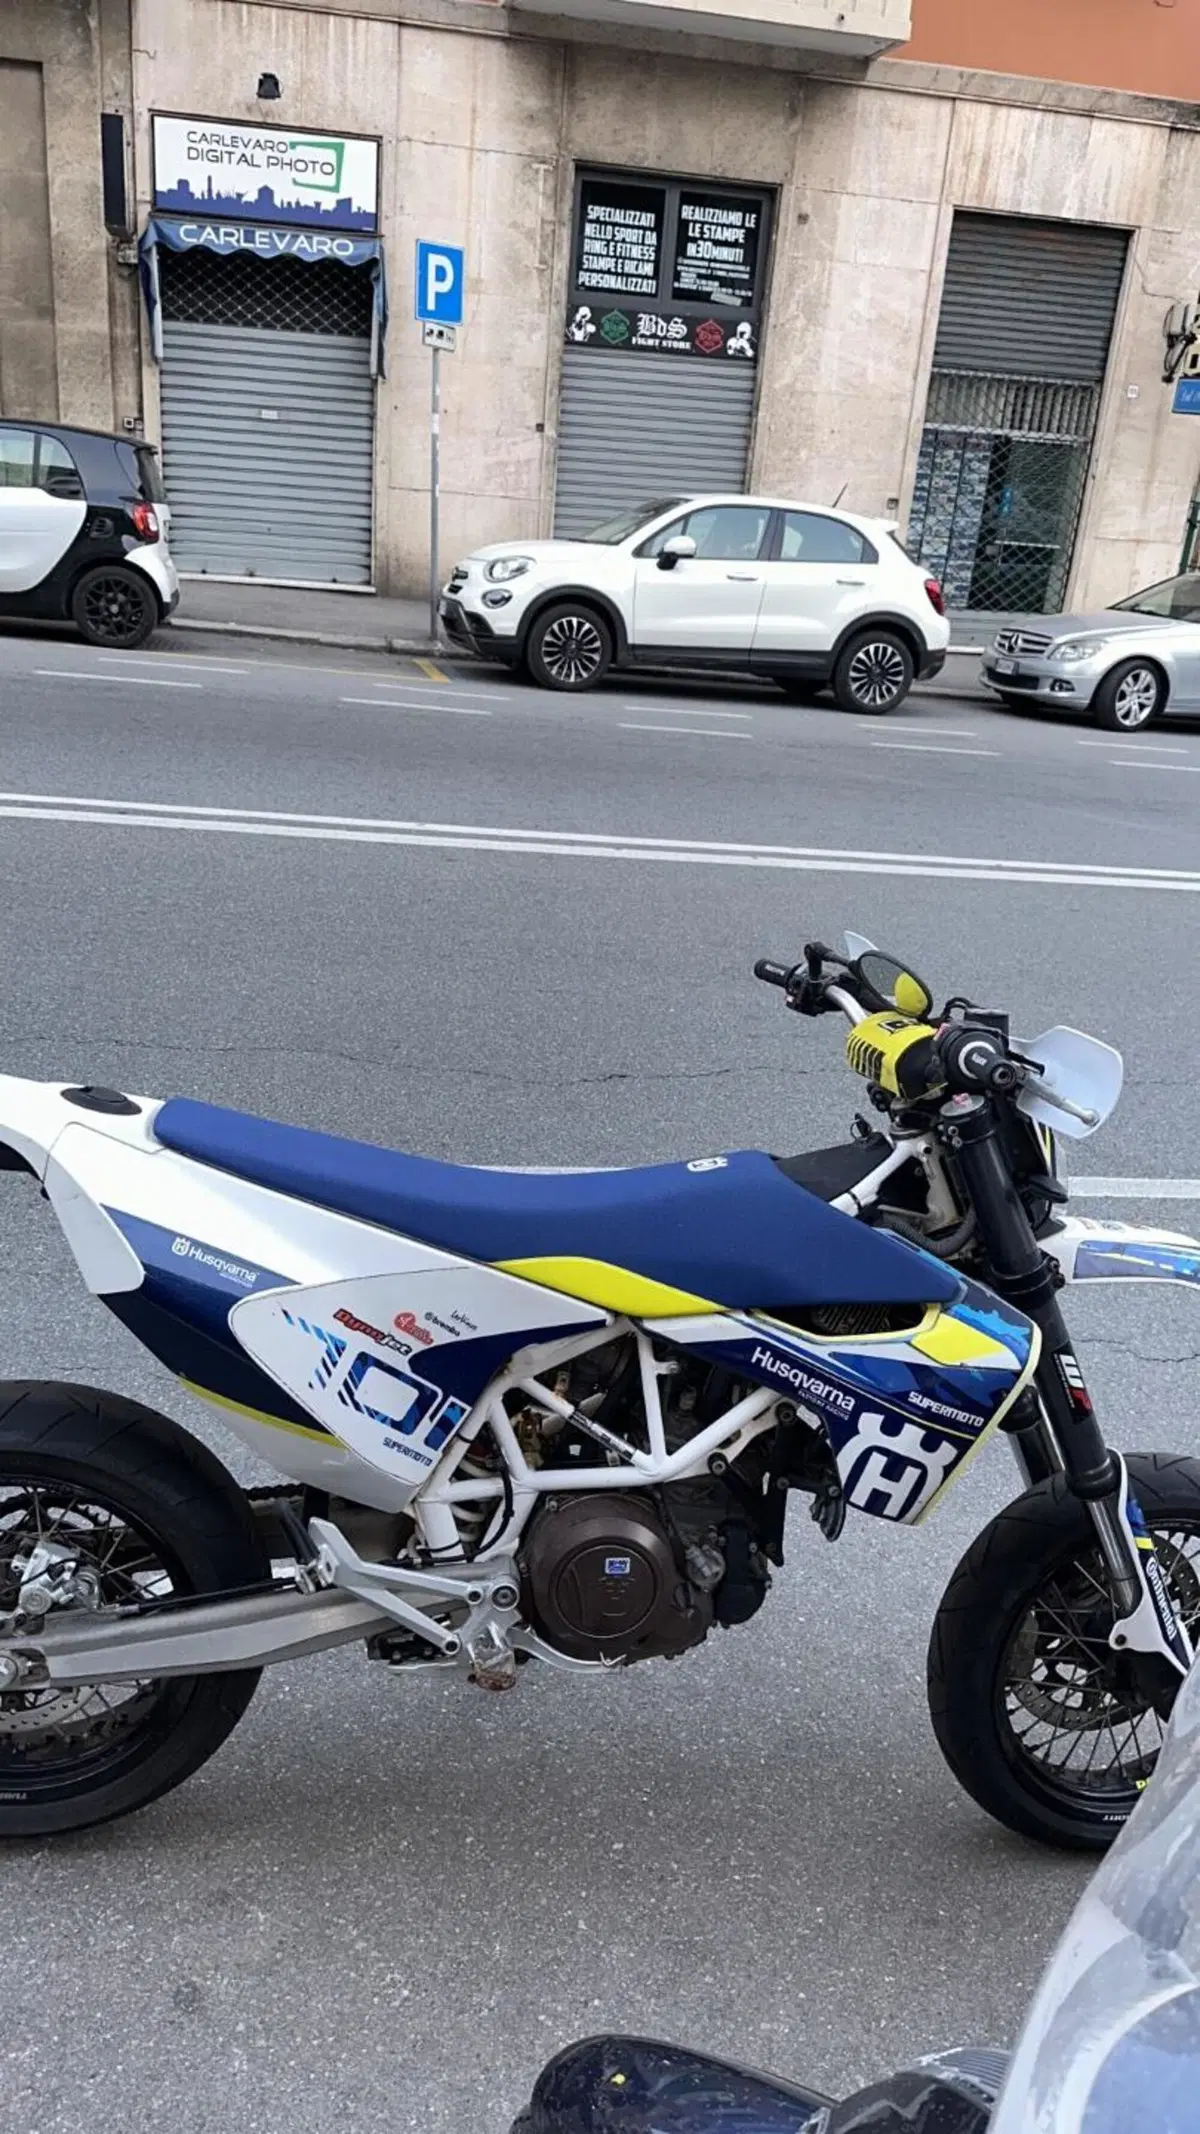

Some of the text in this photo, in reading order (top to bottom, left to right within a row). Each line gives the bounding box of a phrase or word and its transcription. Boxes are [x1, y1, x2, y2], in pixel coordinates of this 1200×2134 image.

[187, 131, 289, 154] CARLEVARO
[187, 147, 336, 176] DIGITAL PHOTO
[587, 204, 656, 228] SPECIALIZZATI
[681, 205, 757, 228] REALIZZIAMO LE
[179, 224, 354, 256] CARLEVARO
[584, 222, 657, 246] NELLO SPORT DA
[688, 222, 746, 243] LE STAMPE
[583, 238, 656, 260] RING E FITNESS
[582, 254, 655, 277] STAMPE E RICAMI
[426, 252, 454, 312] P
[578, 270, 657, 294] PERSONALIZZATI
[631, 336, 692, 350] FIGHT STORE
[188, 1246, 257, 1283] Husqvarna
[751, 1346, 856, 1411] Husqvarna
[907, 1390, 985, 1428] SUPERMOTO
[382, 1436, 433, 1467] SUPERMOTO
